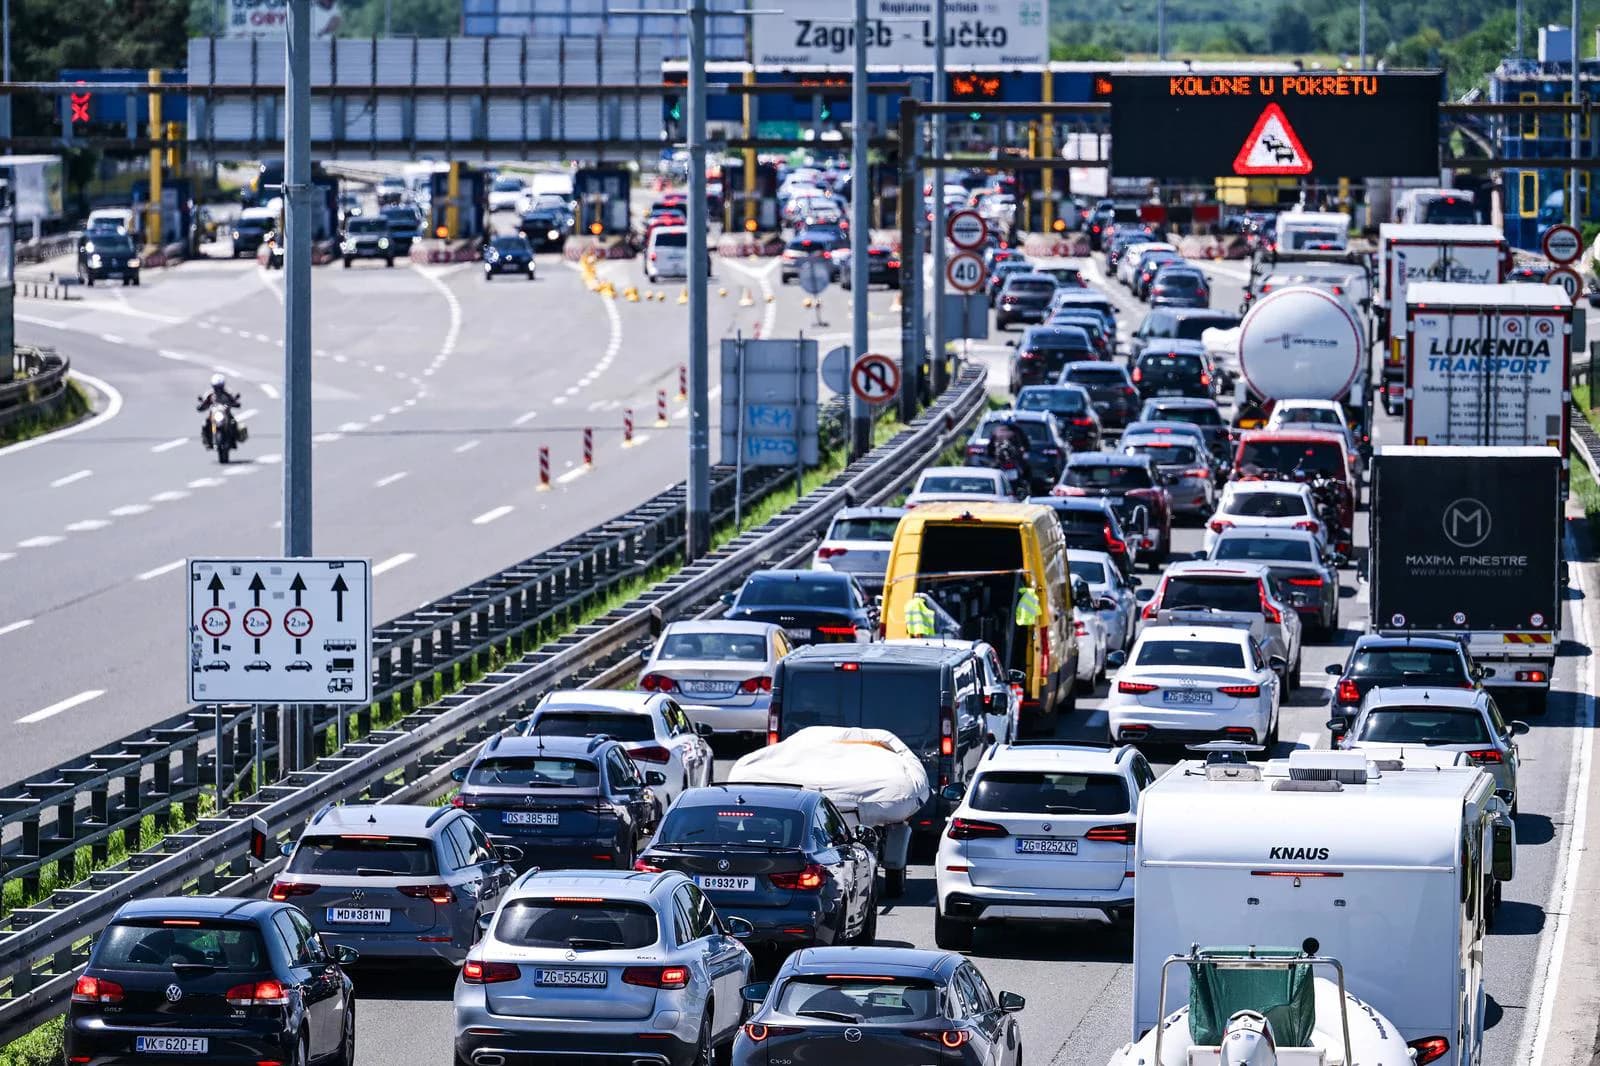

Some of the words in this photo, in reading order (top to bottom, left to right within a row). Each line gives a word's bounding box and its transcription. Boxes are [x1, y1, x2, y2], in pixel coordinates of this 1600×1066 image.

[796, 20, 892, 53] Zagreb
[1170, 76, 1252, 96] KOLONE
[1259, 76, 1275, 96] U
[1282, 76, 1378, 96] POKRETU
[955, 262, 978, 280] 40
[1430, 338, 1551, 357] LUKENDA
[1428, 358, 1550, 375] TRANSPORT
[1452, 508, 1482, 537] M
[1405, 555, 1455, 566] MAXIMA
[1459, 555, 1528, 566] FINESTRE
[507, 813, 519, 823] OS
[1023, 840, 1035, 851] ZG
[1269, 847, 1330, 860] KNAUS
[717, 878, 734, 889] 932
[736, 879, 749, 889] VP
[337, 909, 350, 920] MD
[356, 910, 385, 920] 381NI
[543, 971, 557, 983] ZG
[144, 1038, 158, 1050] VK
